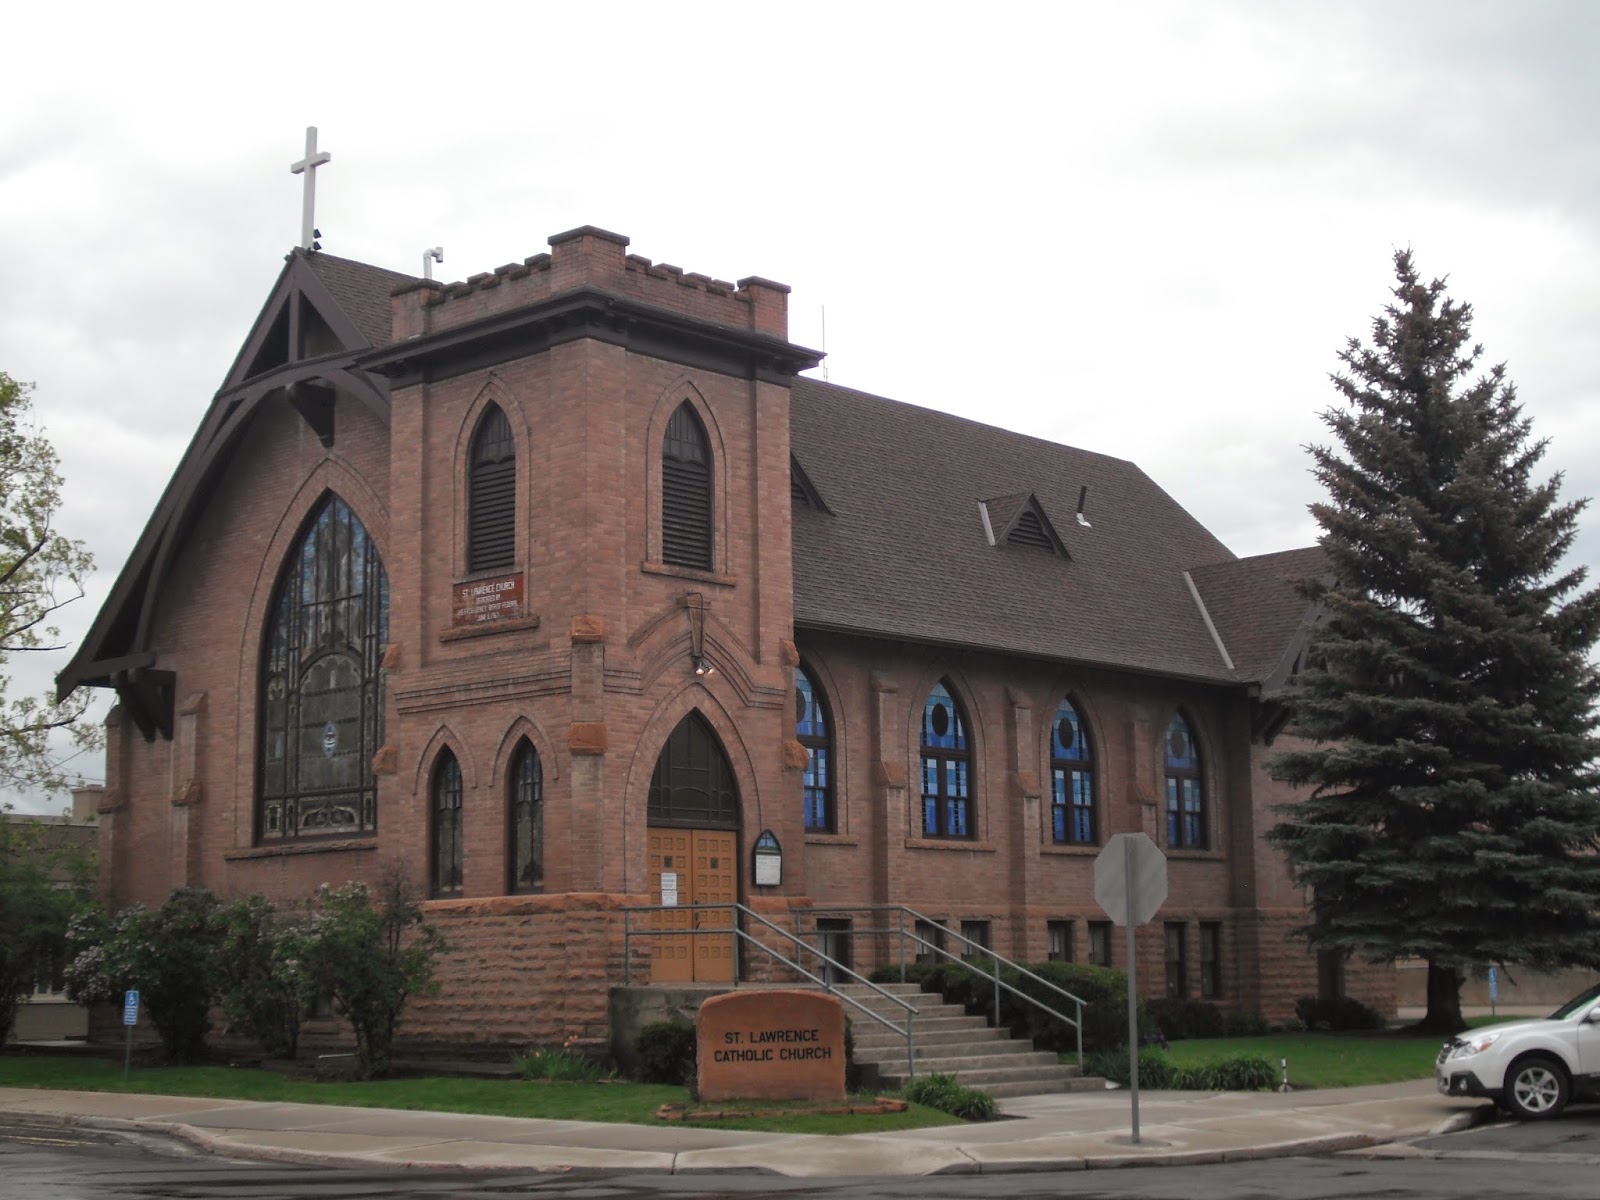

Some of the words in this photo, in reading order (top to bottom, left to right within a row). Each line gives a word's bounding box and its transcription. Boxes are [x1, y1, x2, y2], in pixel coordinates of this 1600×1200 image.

[471, 584, 495, 597] LAWRENCE
[496, 580, 515, 592] CHURCH
[725, 1031, 744, 1044] ST.
[750, 1029, 819, 1044] LAWRENCE
[714, 1049, 773, 1063] CATHOLIC
[780, 1047, 831, 1060] CHURCH
